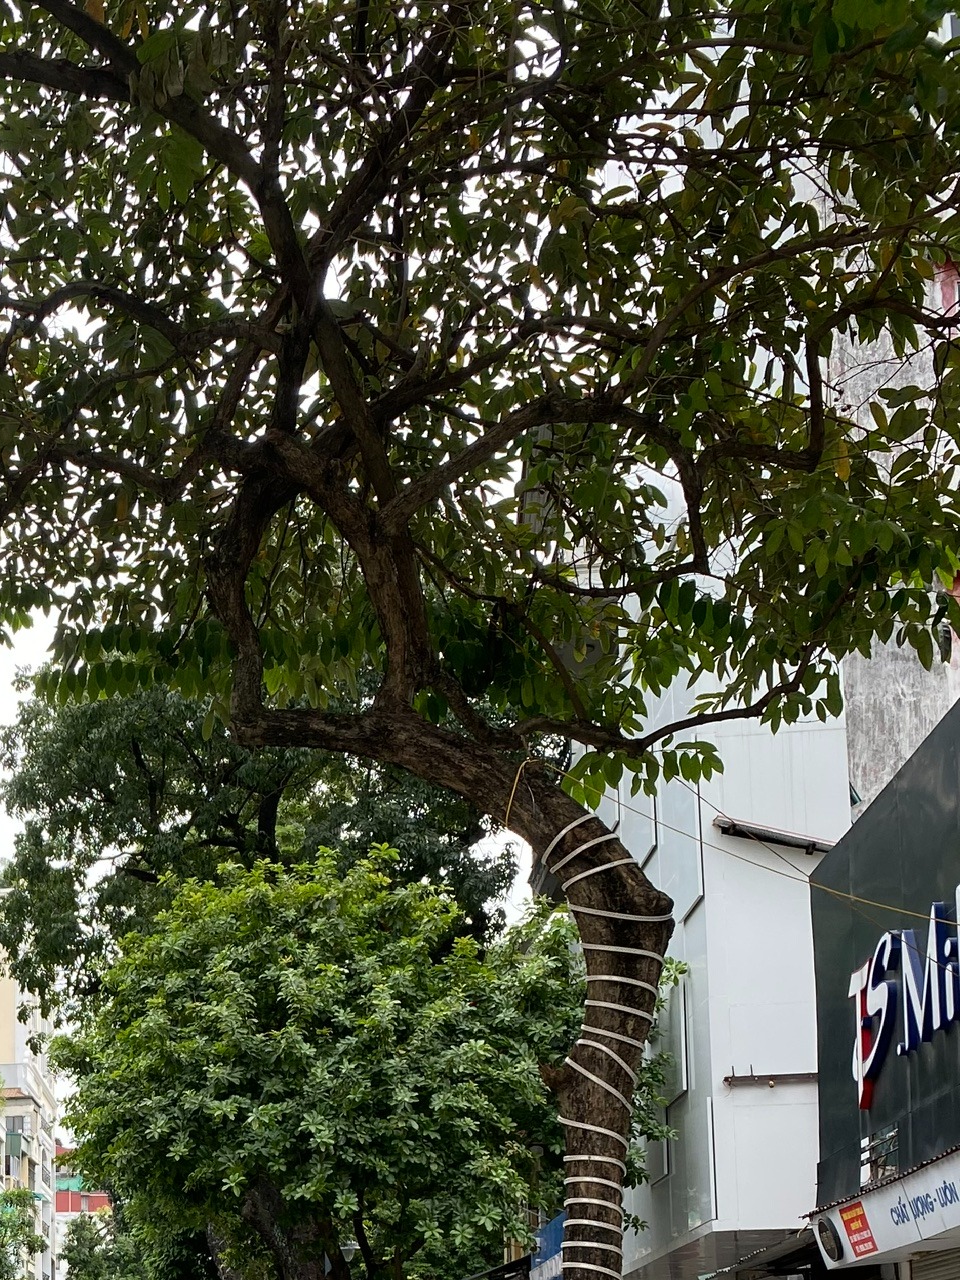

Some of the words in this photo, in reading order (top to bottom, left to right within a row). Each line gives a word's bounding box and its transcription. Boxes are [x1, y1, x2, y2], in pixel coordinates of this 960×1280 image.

[890, 1195, 910, 1226] CHẤT
[908, 1193, 935, 1221] LƯỢNG
[935, 1180, 960, 1208] LUÔN
